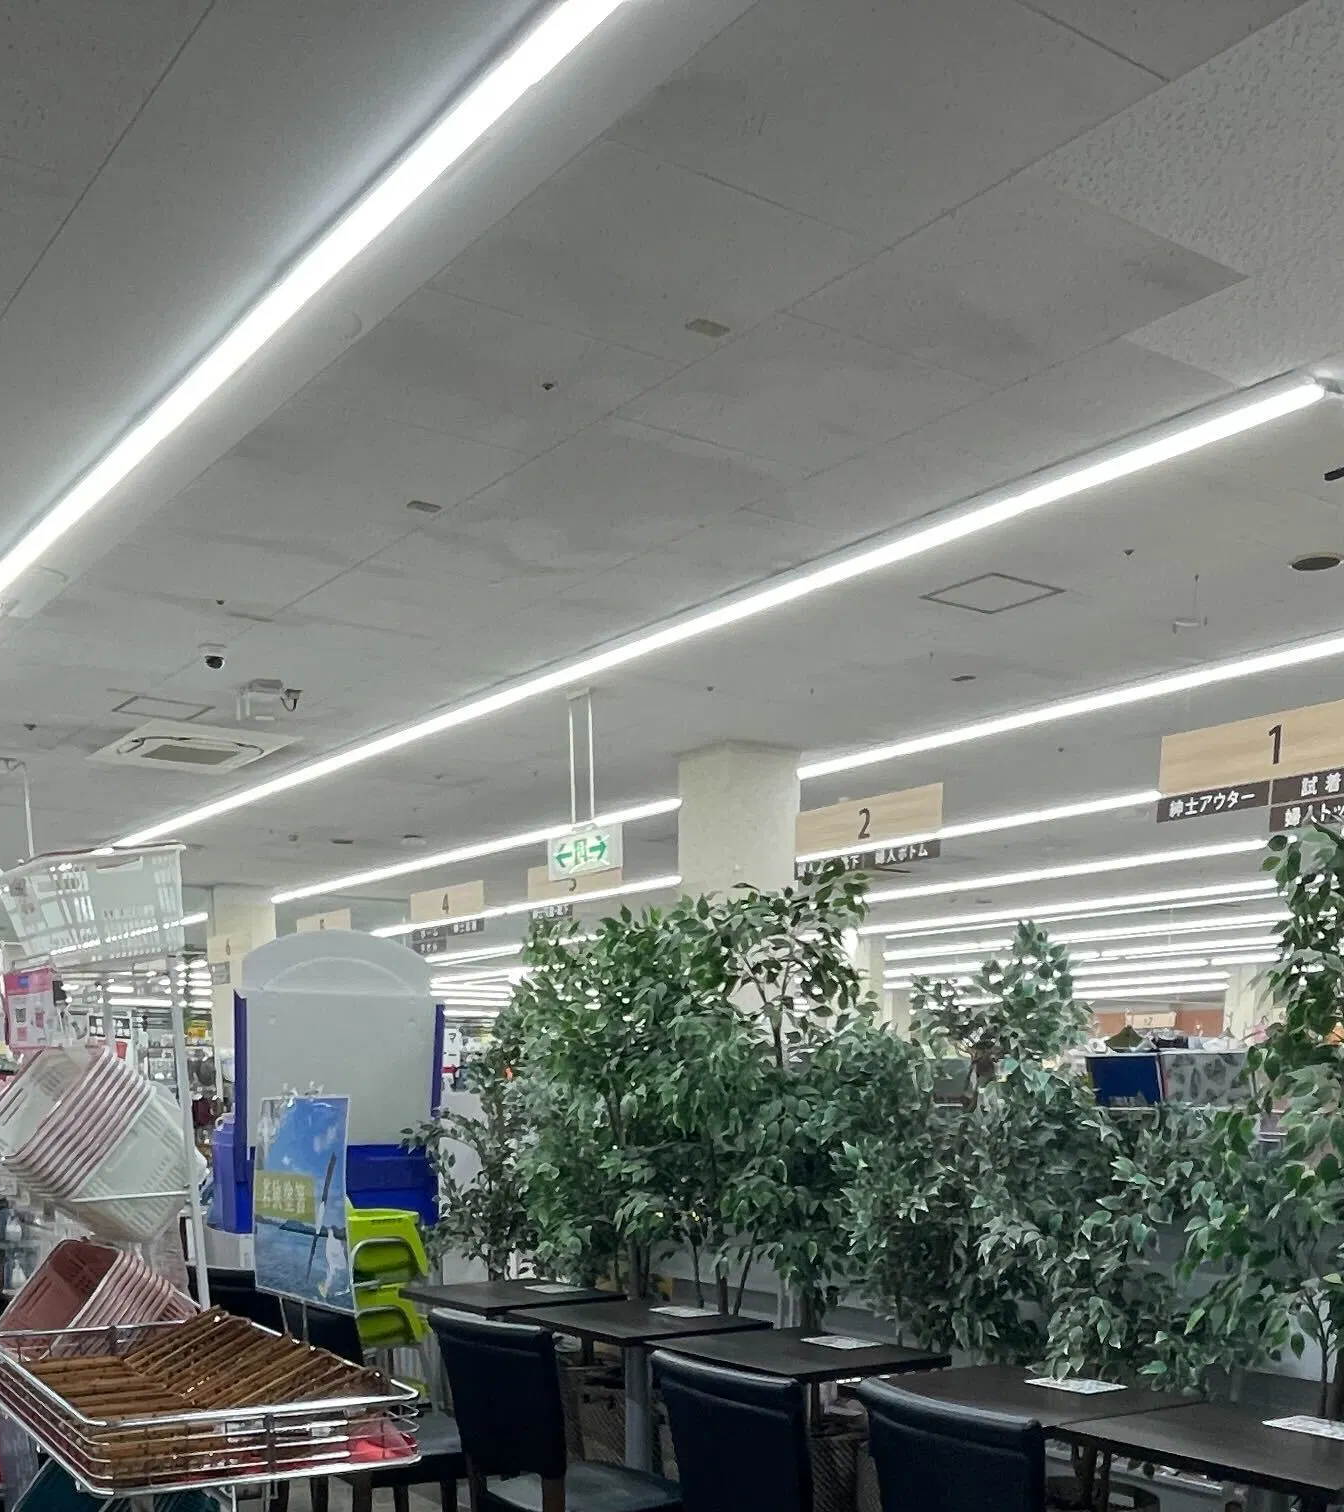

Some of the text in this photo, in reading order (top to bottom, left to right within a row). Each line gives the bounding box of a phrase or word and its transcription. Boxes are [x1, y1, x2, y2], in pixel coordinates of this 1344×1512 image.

[1268, 724, 1282, 765] 1
[1168, 792, 1256, 819] 紳士アウター
[858, 808, 871, 840] 2
